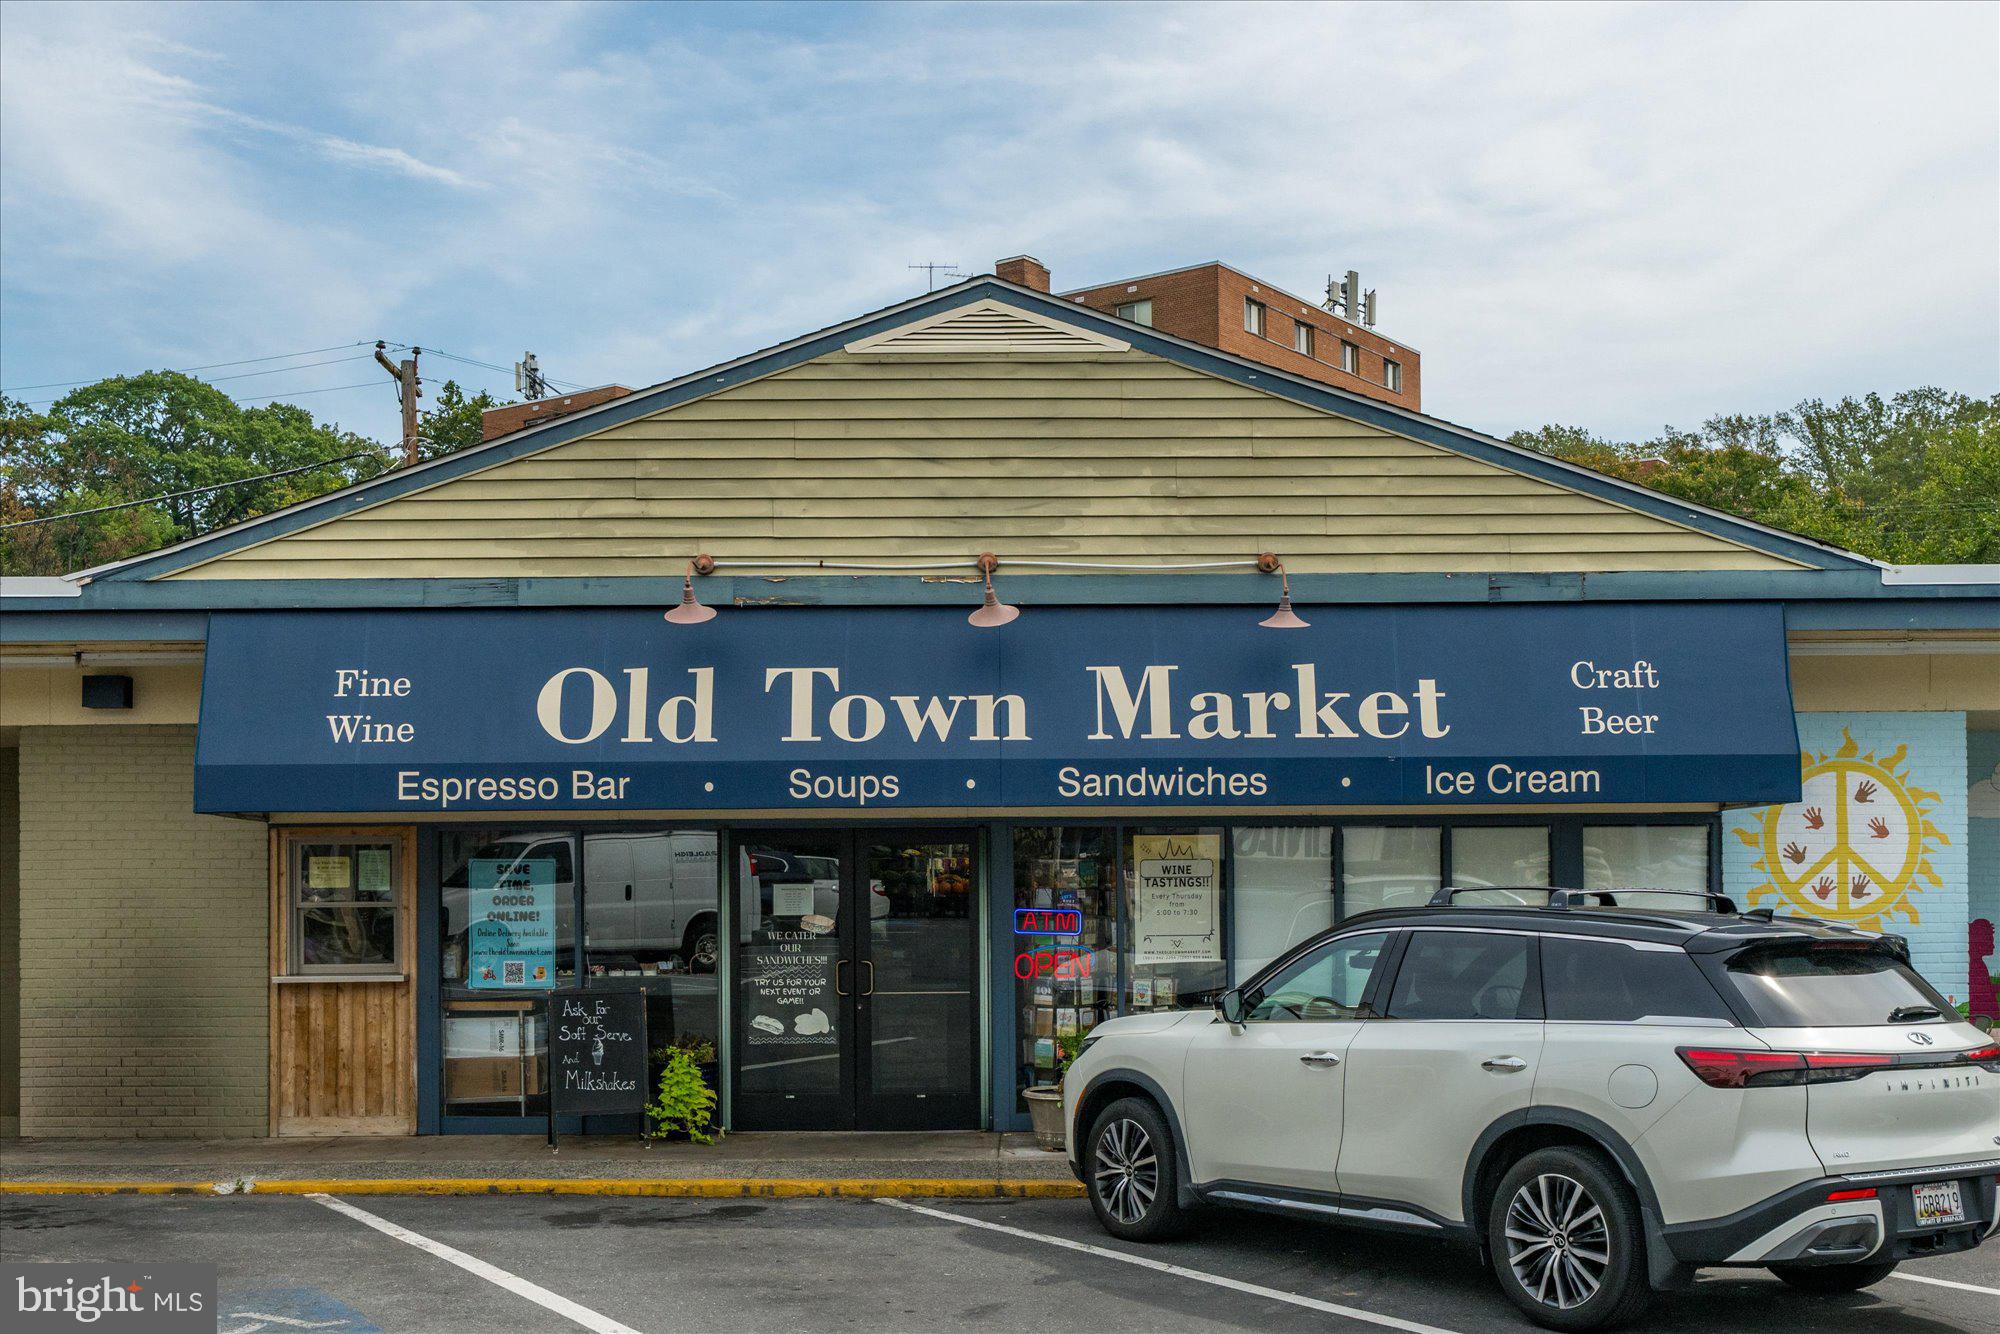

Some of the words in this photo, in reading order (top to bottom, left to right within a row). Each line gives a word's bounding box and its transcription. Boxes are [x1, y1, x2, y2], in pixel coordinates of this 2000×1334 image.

[1571, 660, 1660, 690] Craft
[333, 669, 411, 697] Fine
[536, 666, 718, 745] Old
[764, 667, 1033, 743] Town
[1085, 663, 1451, 740] Market
[1579, 706, 1659, 735] Beer
[325, 715, 415, 744] Wine
[398, 771, 559, 808] Espresso
[572, 770, 631, 800] Bar
[789, 768, 900, 806] Soups
[1058, 766, 1267, 797] Sandwiches
[1426, 765, 1475, 795] Ice
[1487, 763, 1600, 794] Cream
[496, 864, 531, 874] SAVE
[1161, 865, 1192, 875] WINE
[1145, 878, 1209, 888] TASTINGS!!
[492, 895, 535, 906] ORDER
[1151, 893, 1169, 901] Every
[1173, 893, 1203, 901] Thursday
[487, 911, 540, 922] ONLINE!
[1183, 908, 1198, 916] 7:30
[1023, 911, 1077, 931] ATM
[477, 928, 497, 937] Online
[498, 928, 521, 939] Delivery
[523, 928, 549, 937] Available
[767, 931, 783, 940] WE
[785, 931, 817, 940] CATER
[780, 943, 802, 952] OUR
[1014, 952, 1092, 980] OPEN
[754, 978, 770, 986] TRY
[772, 978, 785, 986] US
[786, 978, 802, 986] FOR
[804, 978, 827, 986] YOUR
[809, 987, 821, 995] OR
[776, 997, 804, 1005] GAME!!
[562, 999, 588, 1017] Ask
[595, 1000, 611, 1015] For
[582, 1016, 603, 1025] our
[558, 1025, 587, 1041] Soft
[593, 1024, 633, 1042] Serve
[561, 1051, 580, 1064] And
[564, 1069, 637, 1091] Milkshakes
[1886, 1075, 1980, 1091] INFINITI
[1916, 1191, 1960, 1217] 7GB8219
